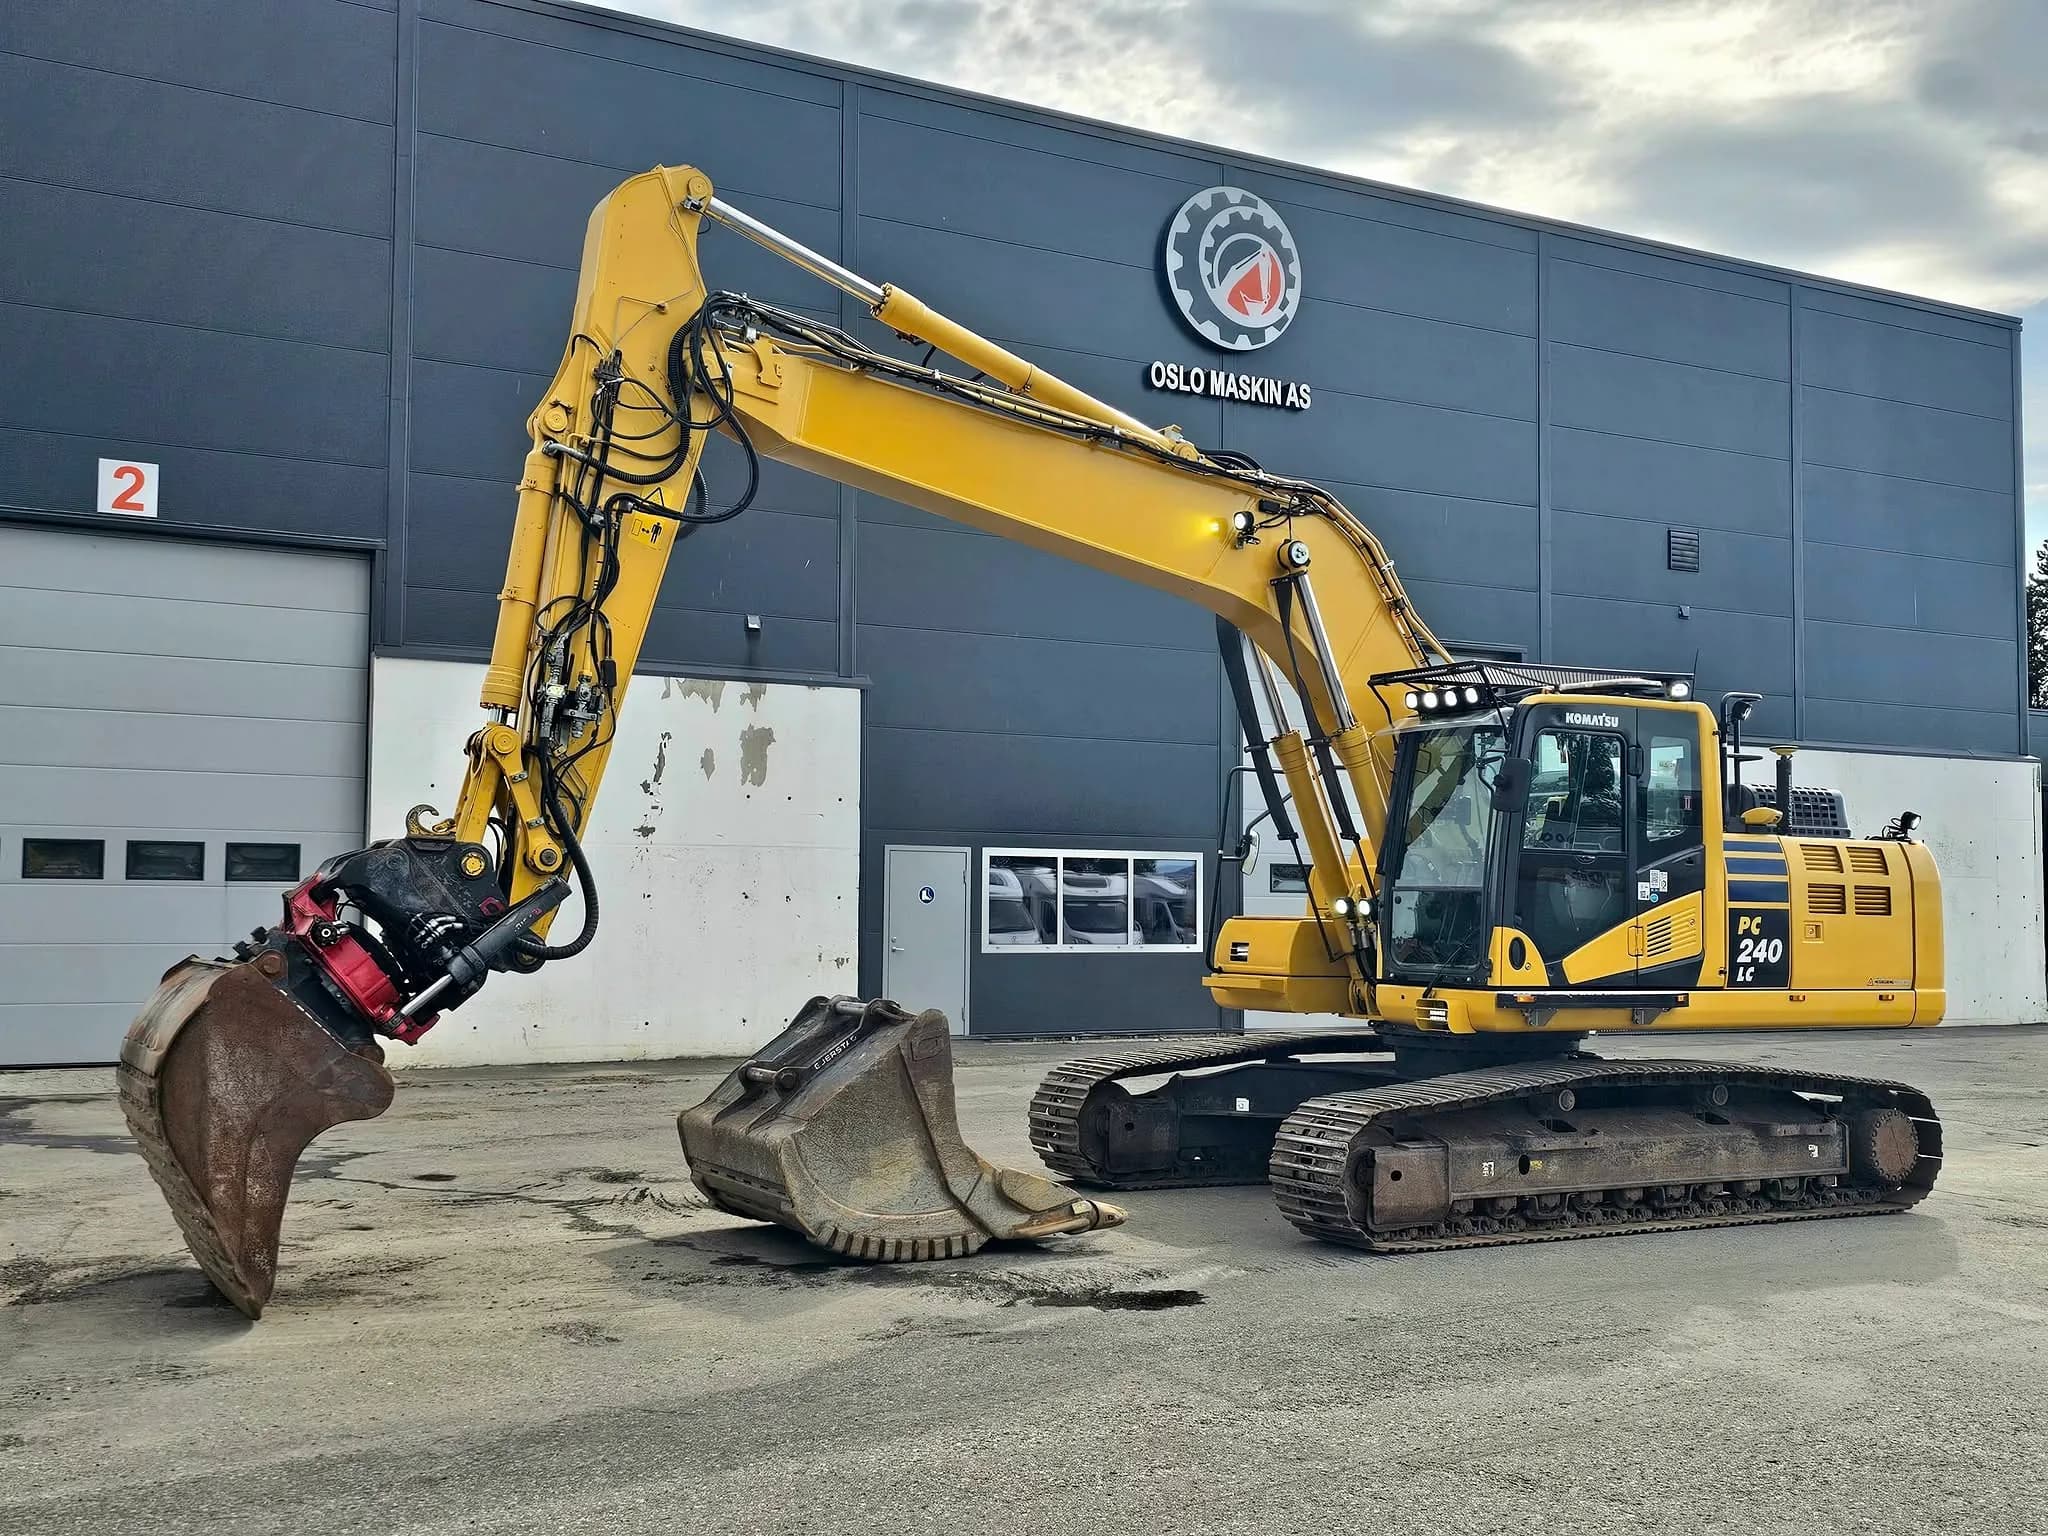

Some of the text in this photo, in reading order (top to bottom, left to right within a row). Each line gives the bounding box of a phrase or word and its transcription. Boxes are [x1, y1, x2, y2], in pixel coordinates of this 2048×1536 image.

[1151, 361, 1312, 410] OSLO MASKIN AS
[112, 465, 145, 512] 2
[1565, 712, 1619, 728] KOMATSU
[1738, 916, 1762, 935] PC
[1736, 938, 1783, 964] 240
[1736, 966, 1755, 982] LC
